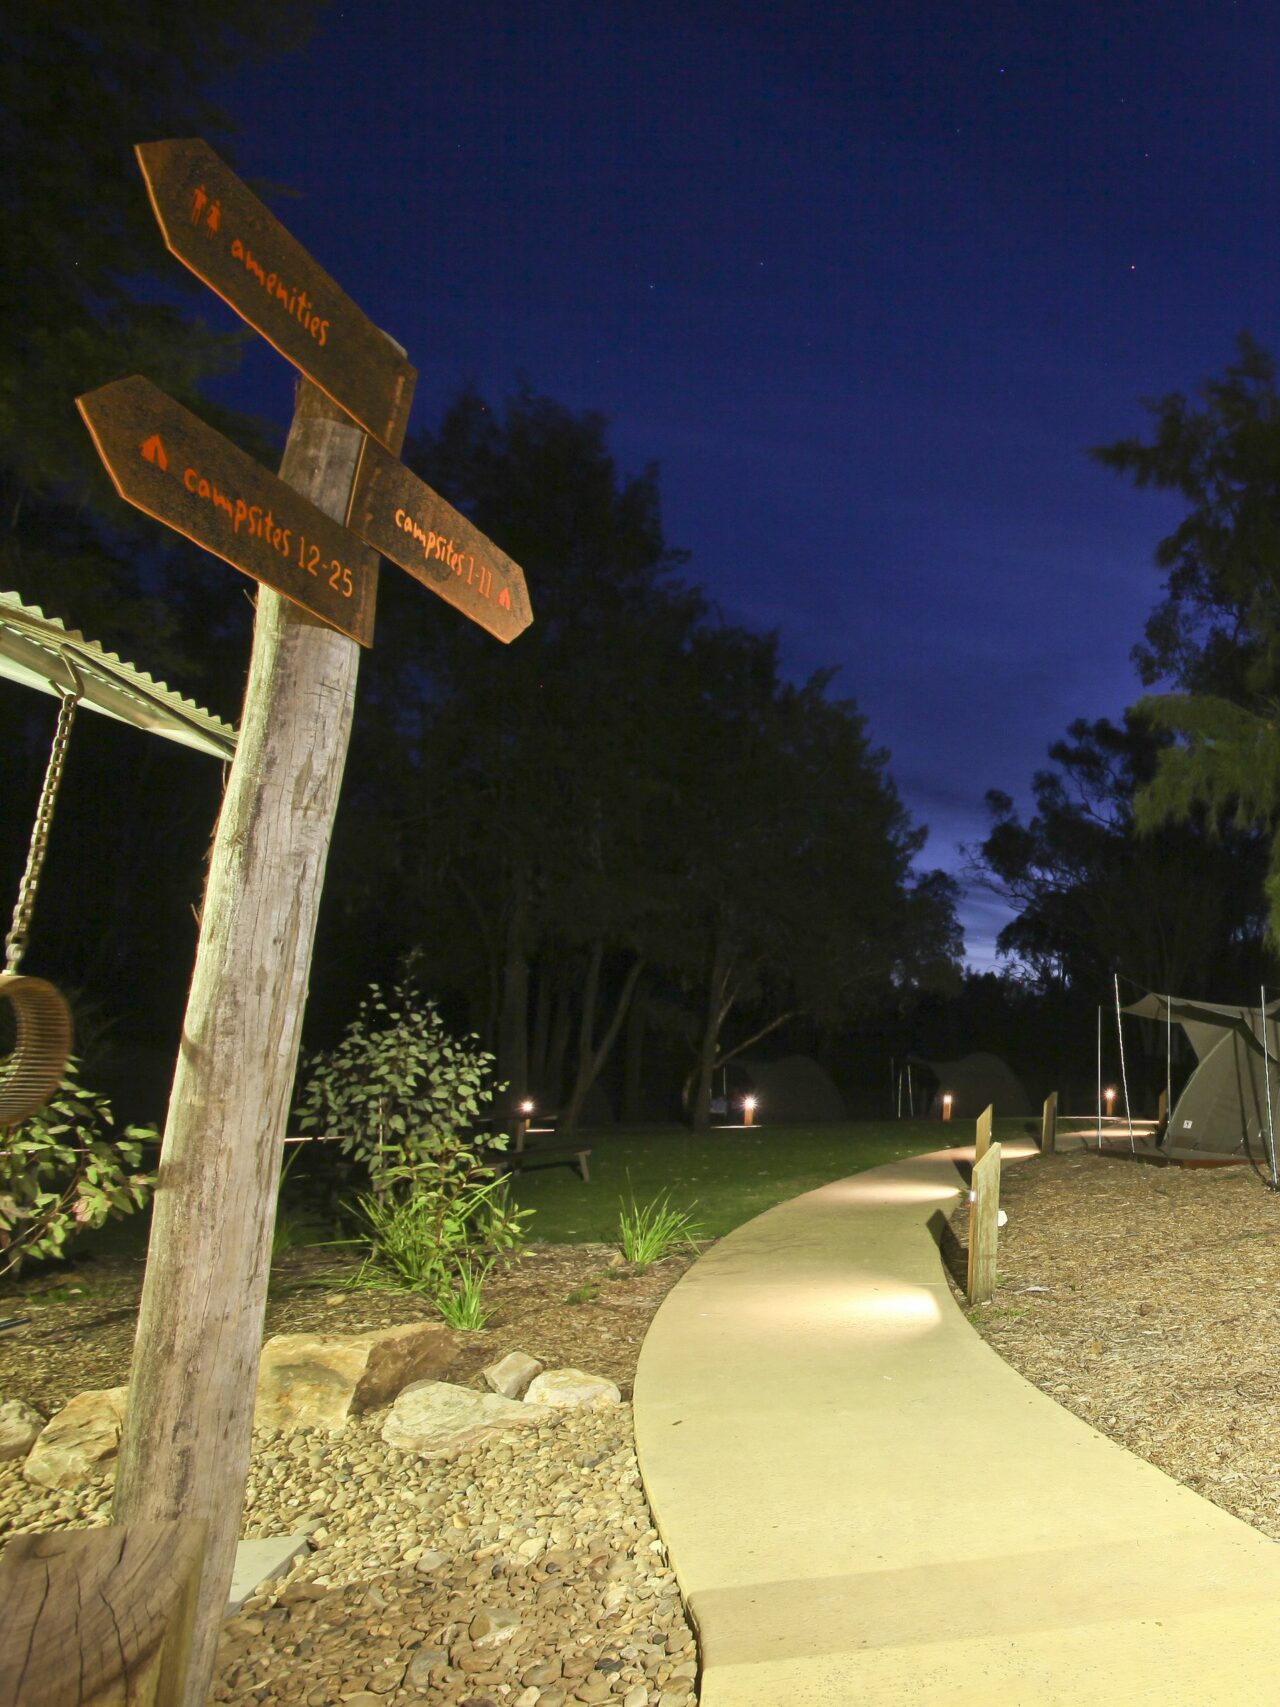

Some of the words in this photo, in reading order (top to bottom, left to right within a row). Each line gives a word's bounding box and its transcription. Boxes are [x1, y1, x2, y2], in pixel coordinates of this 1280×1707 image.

[231, 239, 330, 347] amenities
[183, 467, 292, 557] campsites
[298, 536, 353, 598] 12-25
[395, 508, 465, 576] campsites
